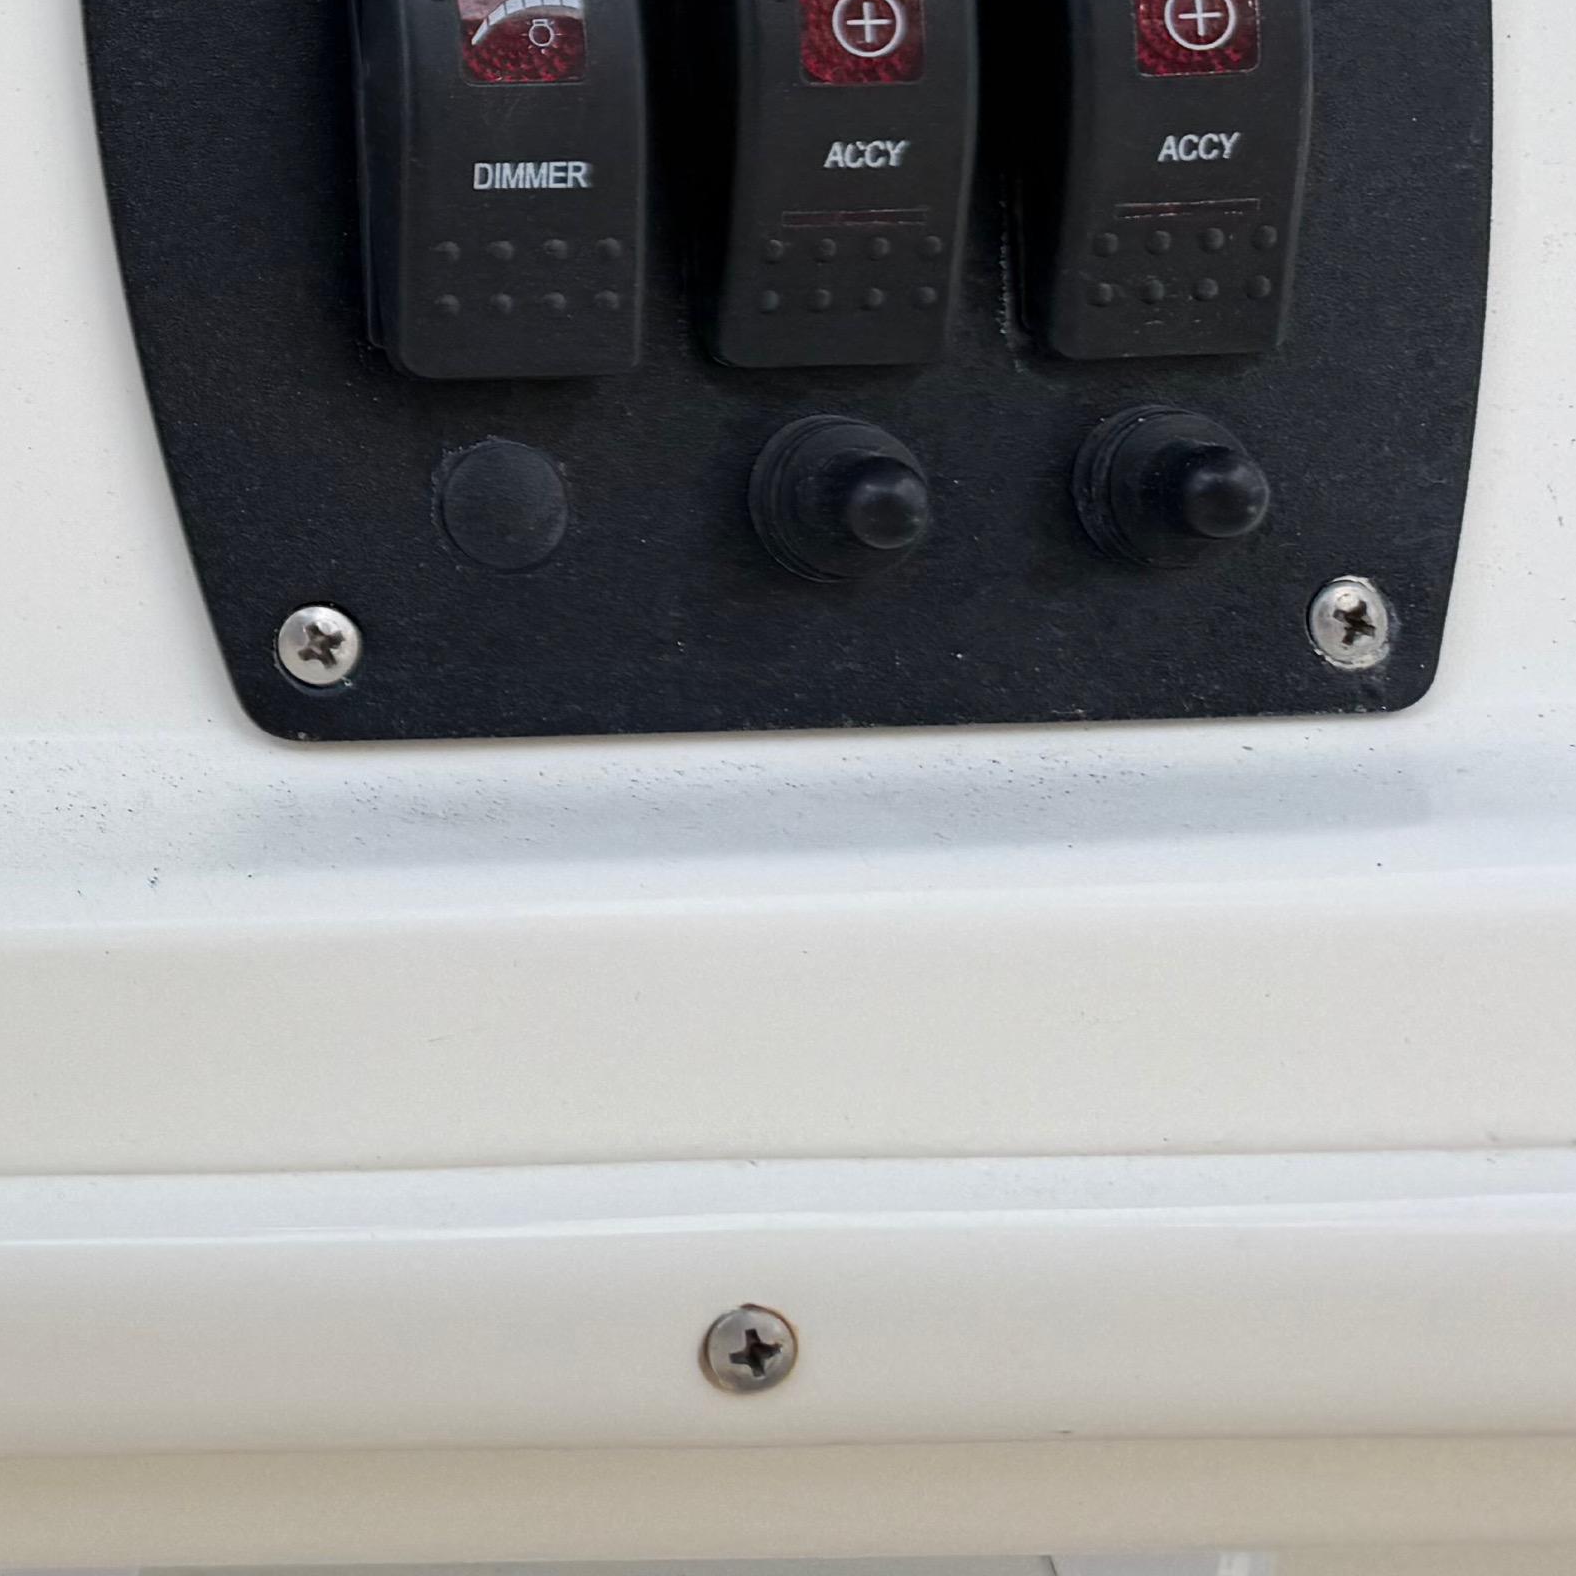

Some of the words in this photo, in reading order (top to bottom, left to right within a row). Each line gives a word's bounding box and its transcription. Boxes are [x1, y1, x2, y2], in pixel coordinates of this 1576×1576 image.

[823, 140, 906, 168] ACCY
[1157, 132, 1240, 162] ACCY
[473, 161, 588, 190] DIMMER
